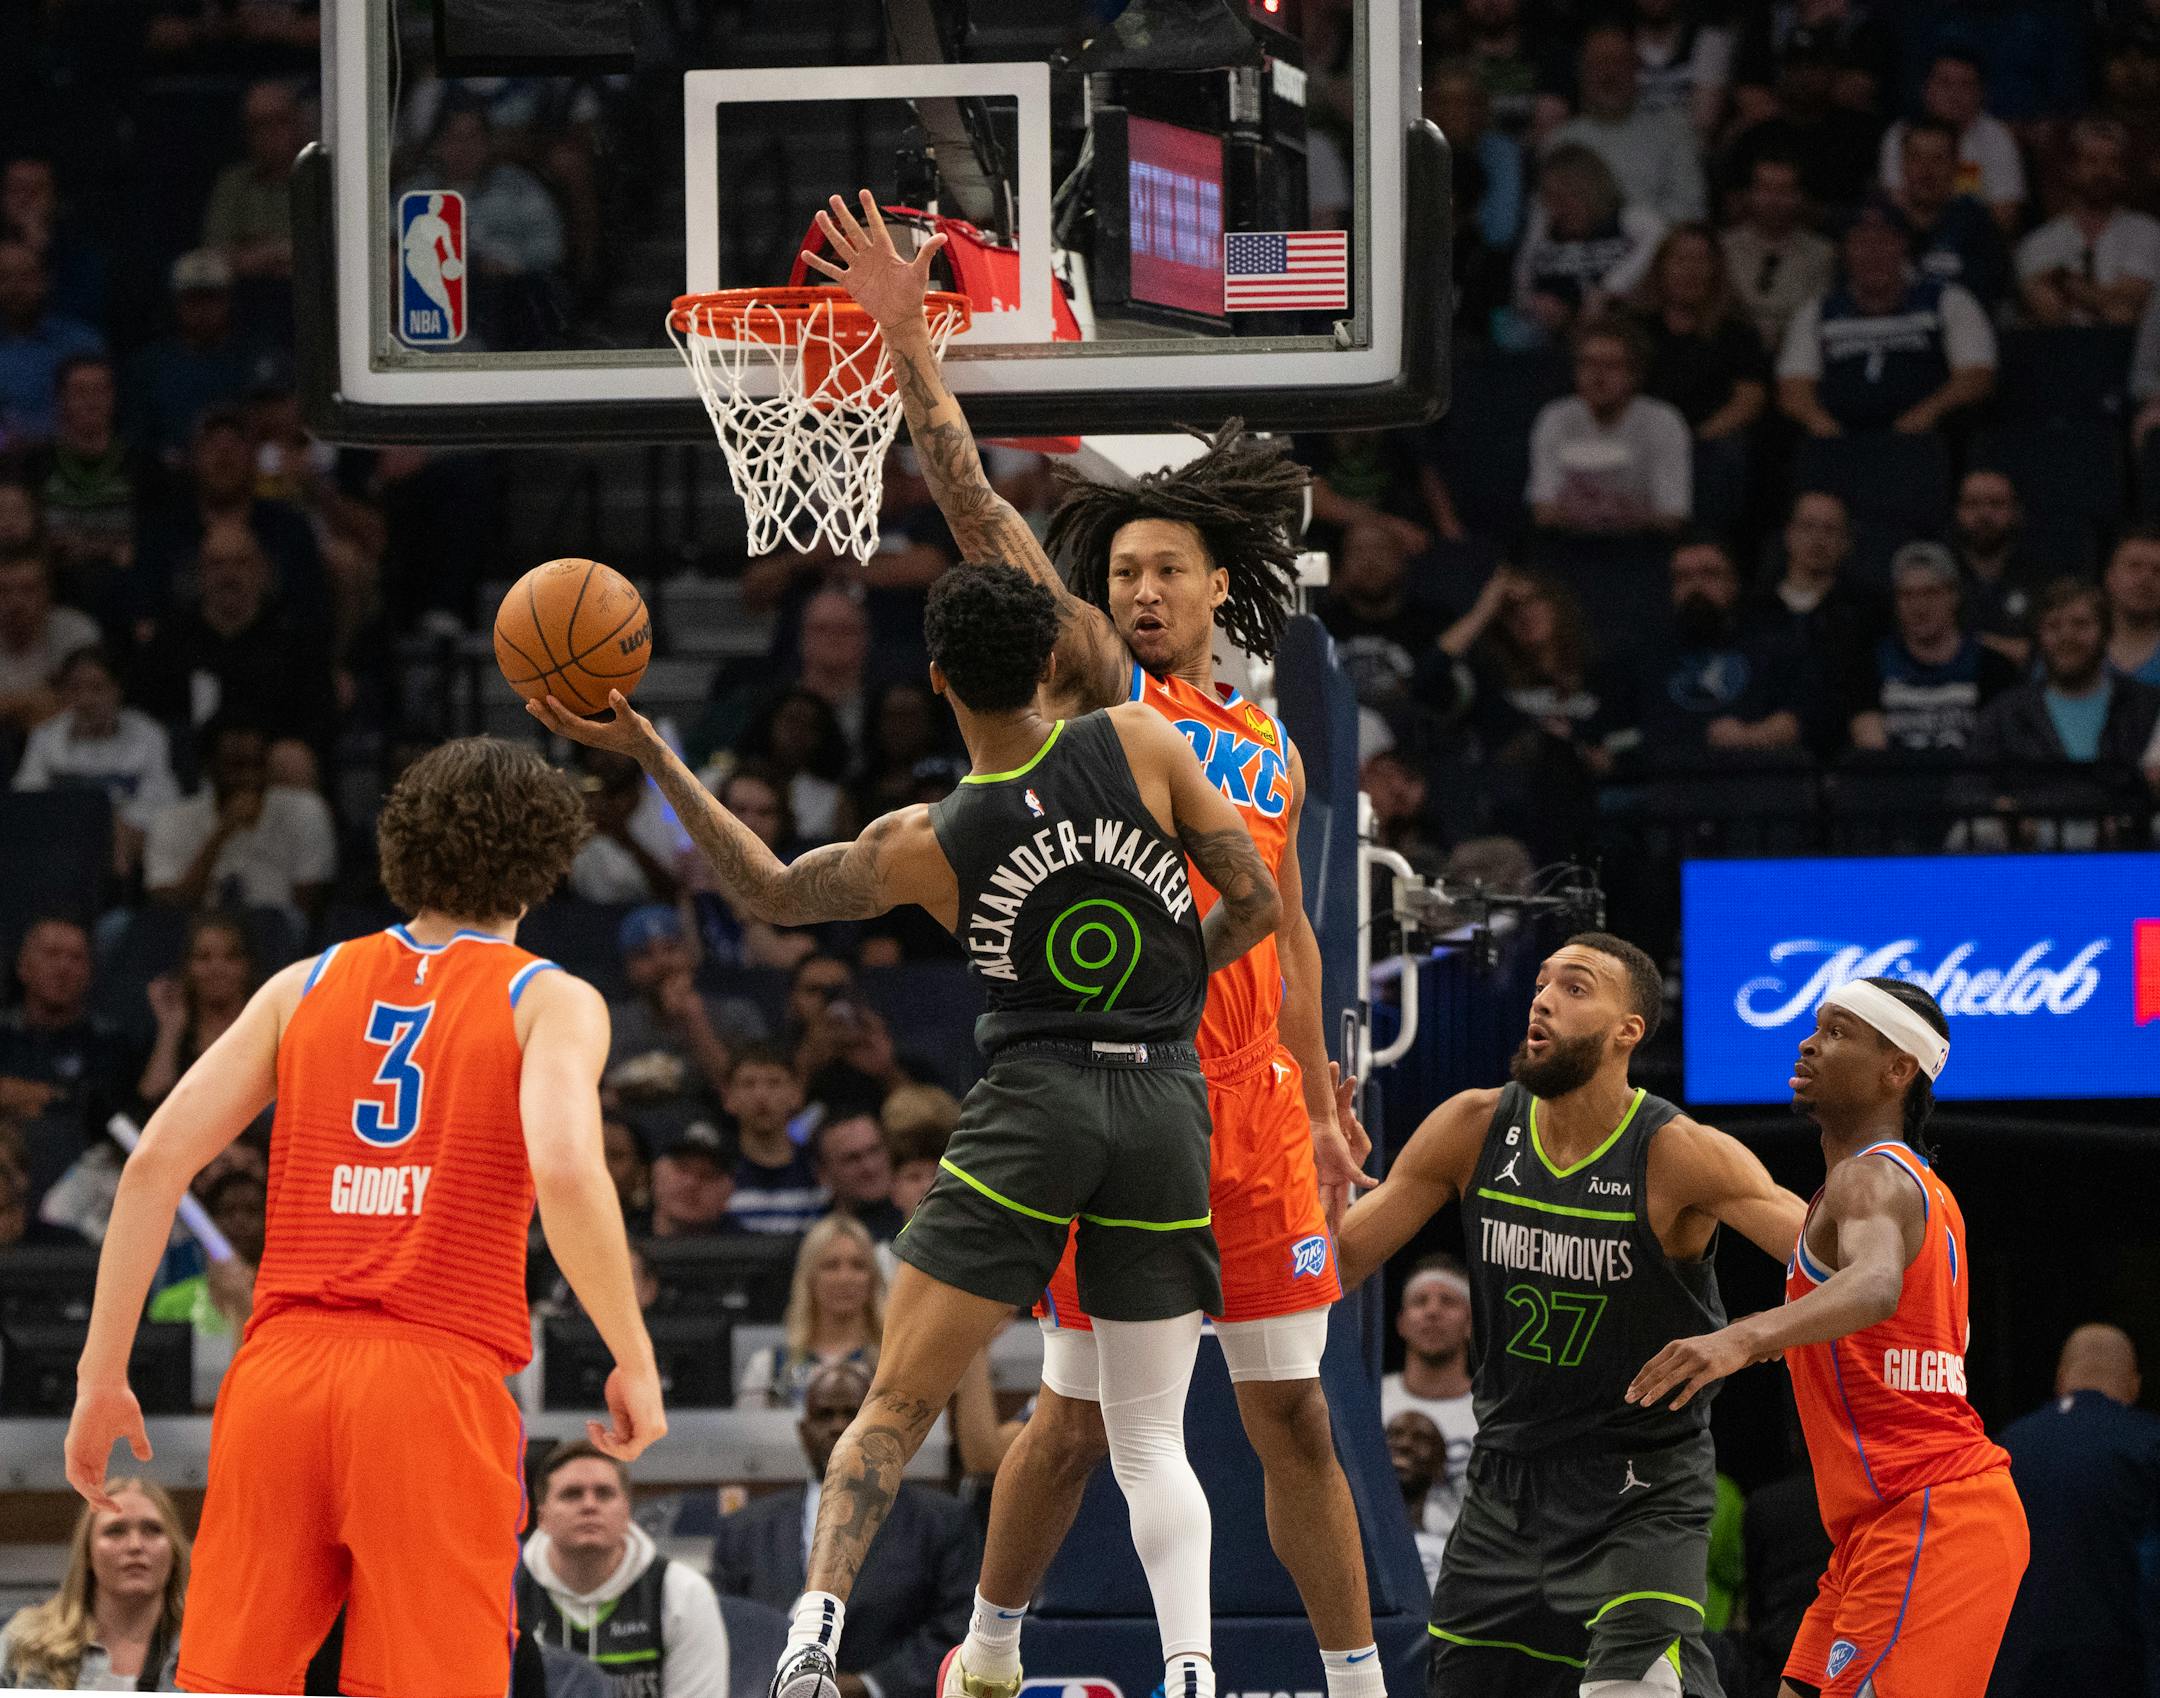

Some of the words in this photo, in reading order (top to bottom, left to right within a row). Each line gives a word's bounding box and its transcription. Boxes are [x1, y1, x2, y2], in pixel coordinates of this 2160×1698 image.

[409, 309, 441, 334] NBA
[968, 818, 1193, 981] ALEXANDER-WALKER
[1045, 898, 1142, 1014] 9
[351, 999, 437, 1149] 3
[1505, 1126, 1521, 1146] 6
[330, 1164, 432, 1216] GIDDEY
[1480, 1217, 1634, 1289] TIMBERWOLVES
[1504, 1283, 1608, 1367] 27
